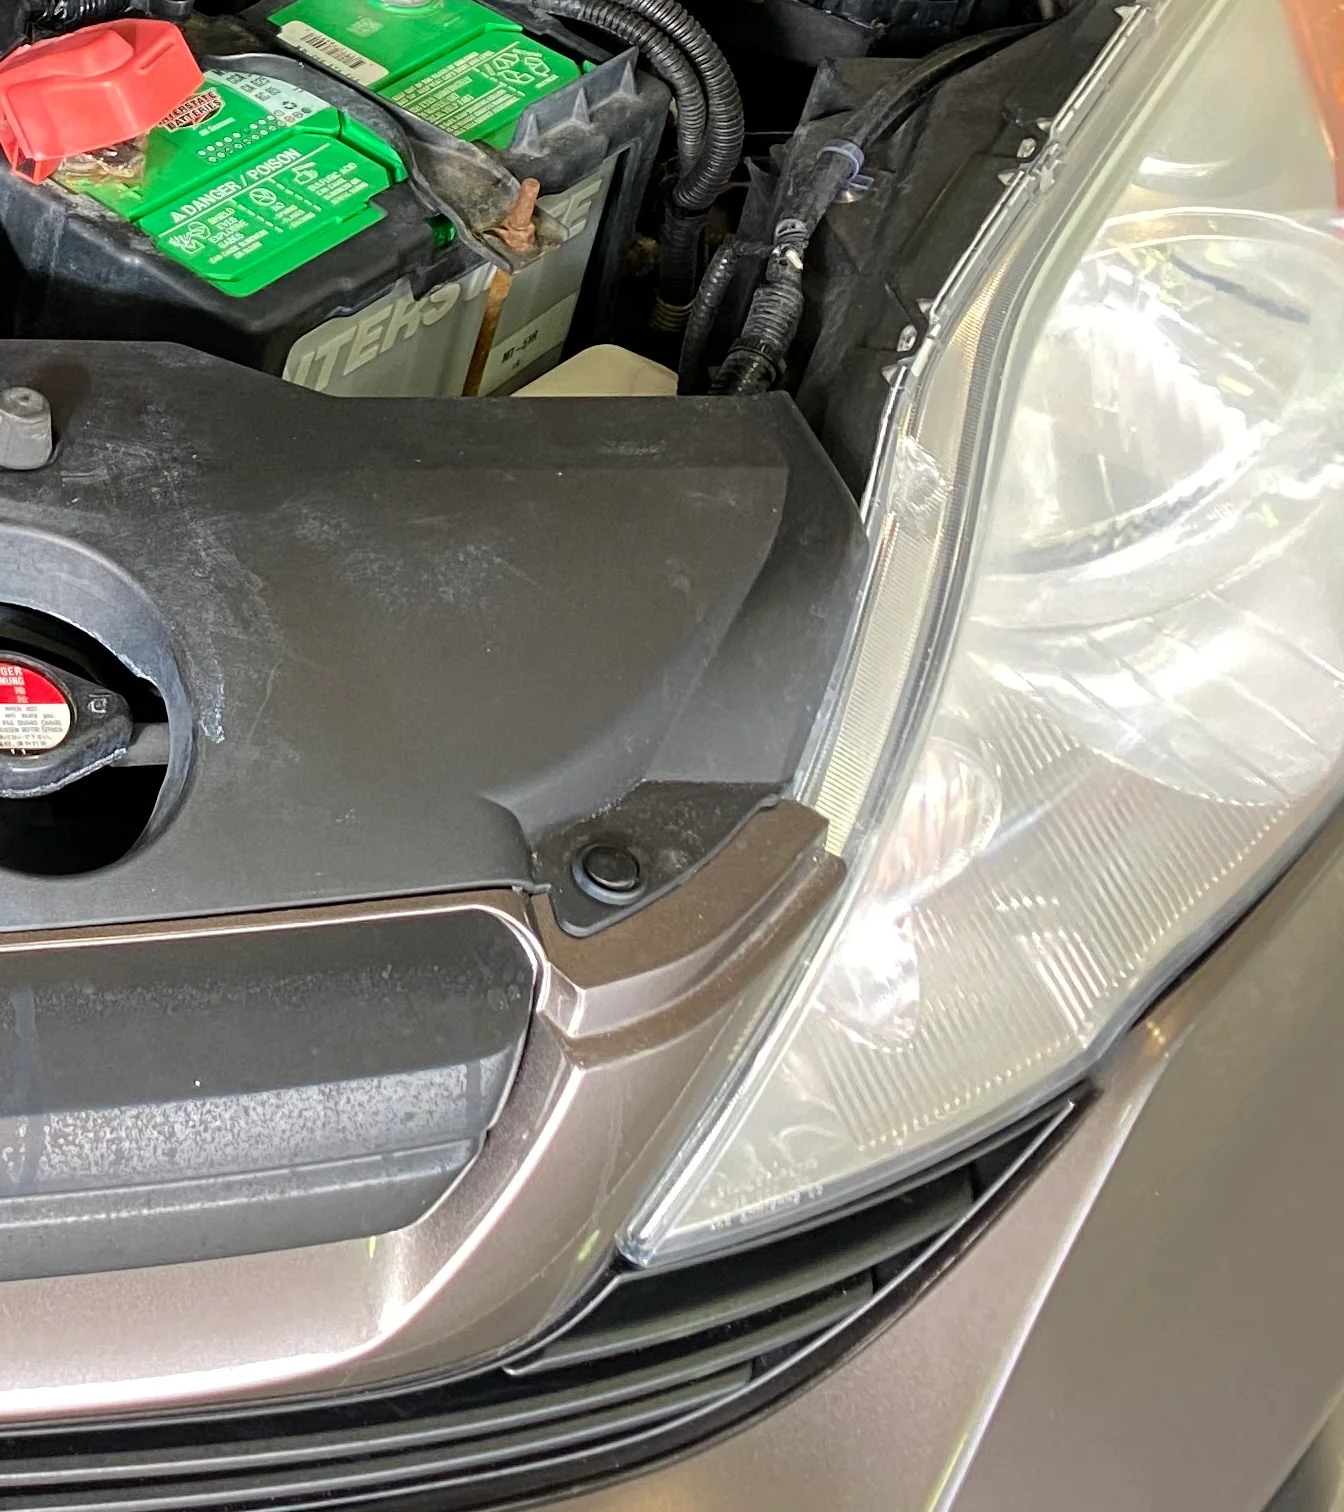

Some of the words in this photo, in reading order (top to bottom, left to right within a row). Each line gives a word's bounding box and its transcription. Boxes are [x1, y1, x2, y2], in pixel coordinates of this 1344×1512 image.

[167, 99, 222, 130] BATTERIES
[181, 180, 242, 216] DANGER
[246, 147, 302, 181] POISON
